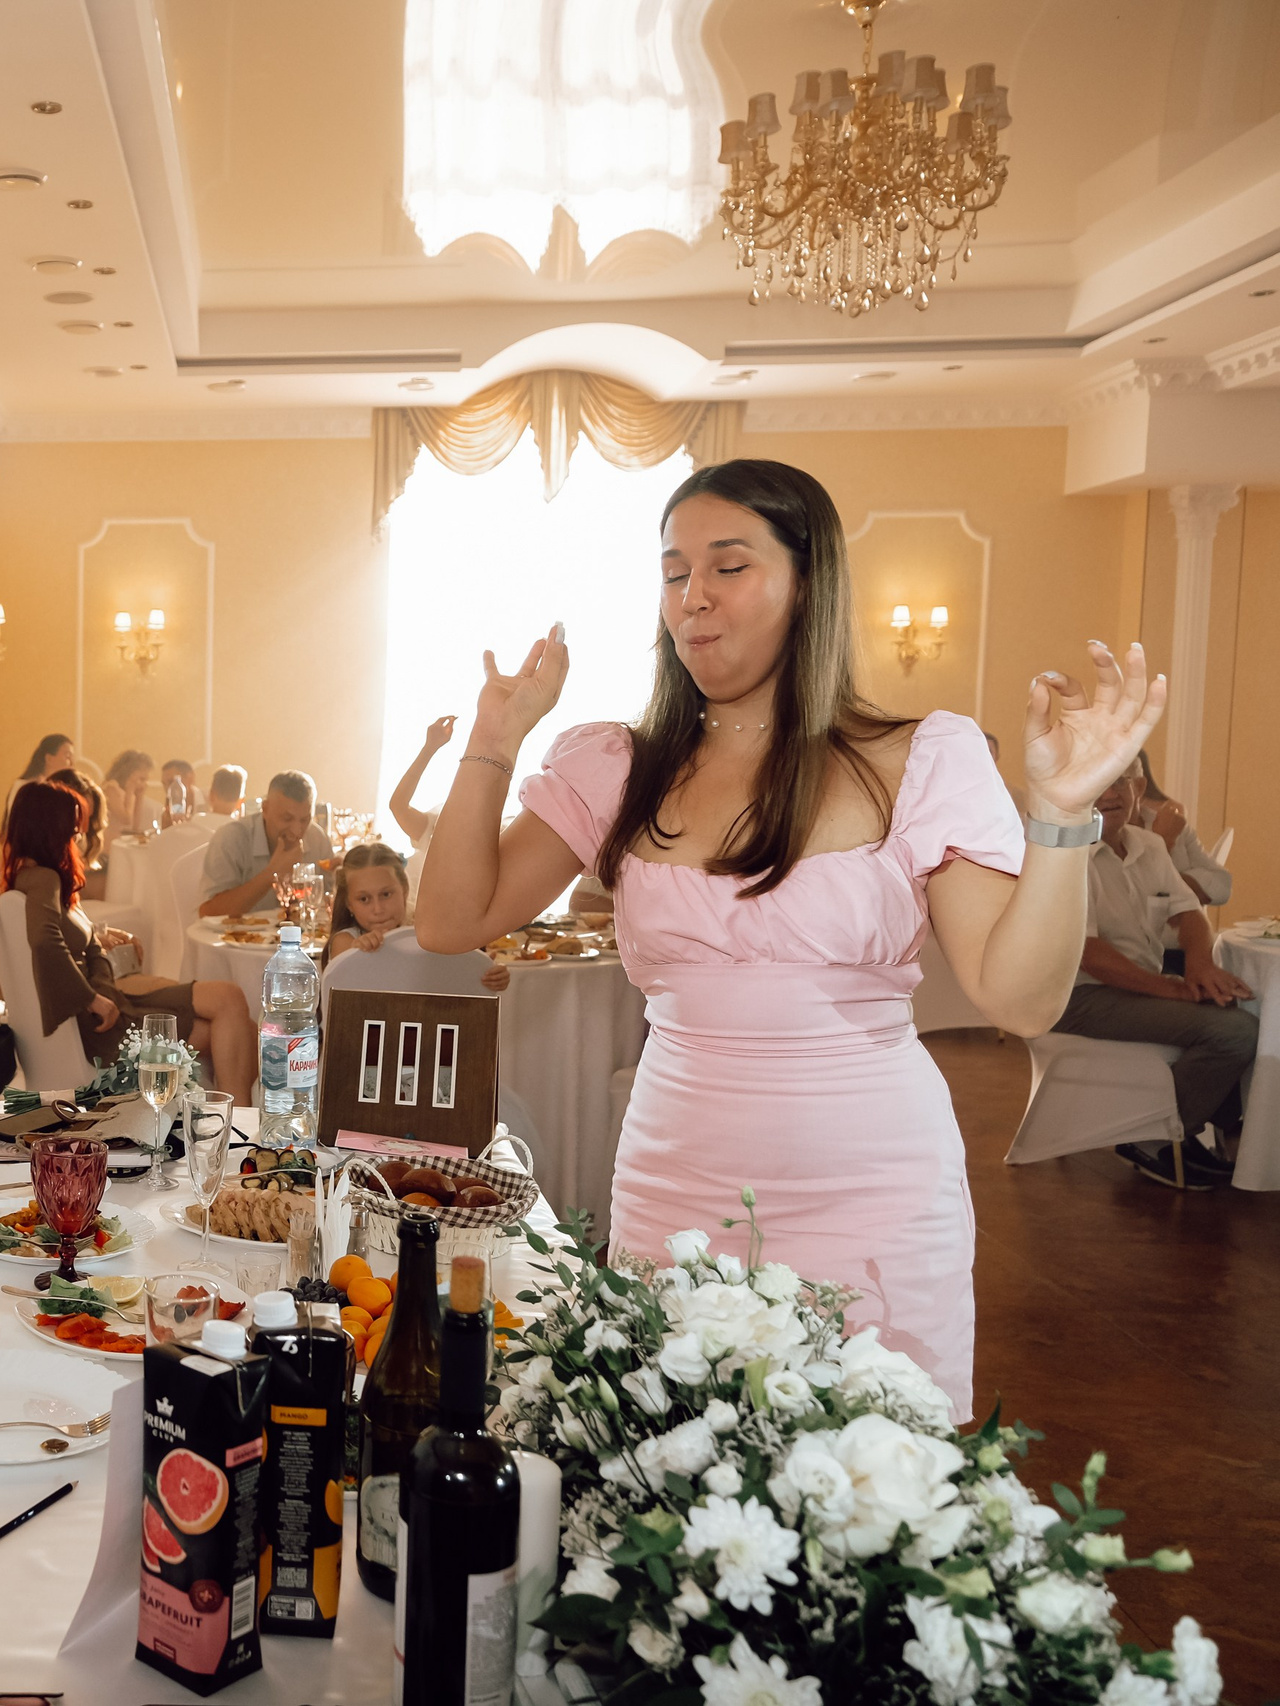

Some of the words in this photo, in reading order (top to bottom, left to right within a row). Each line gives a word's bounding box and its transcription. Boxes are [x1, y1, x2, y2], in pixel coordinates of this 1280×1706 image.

[289, 1059, 318, 1072] КАРАЧИН
[143, 1409, 186, 1441] PREMIUM
[140, 1590, 203, 1628] RAPEFRUIT
